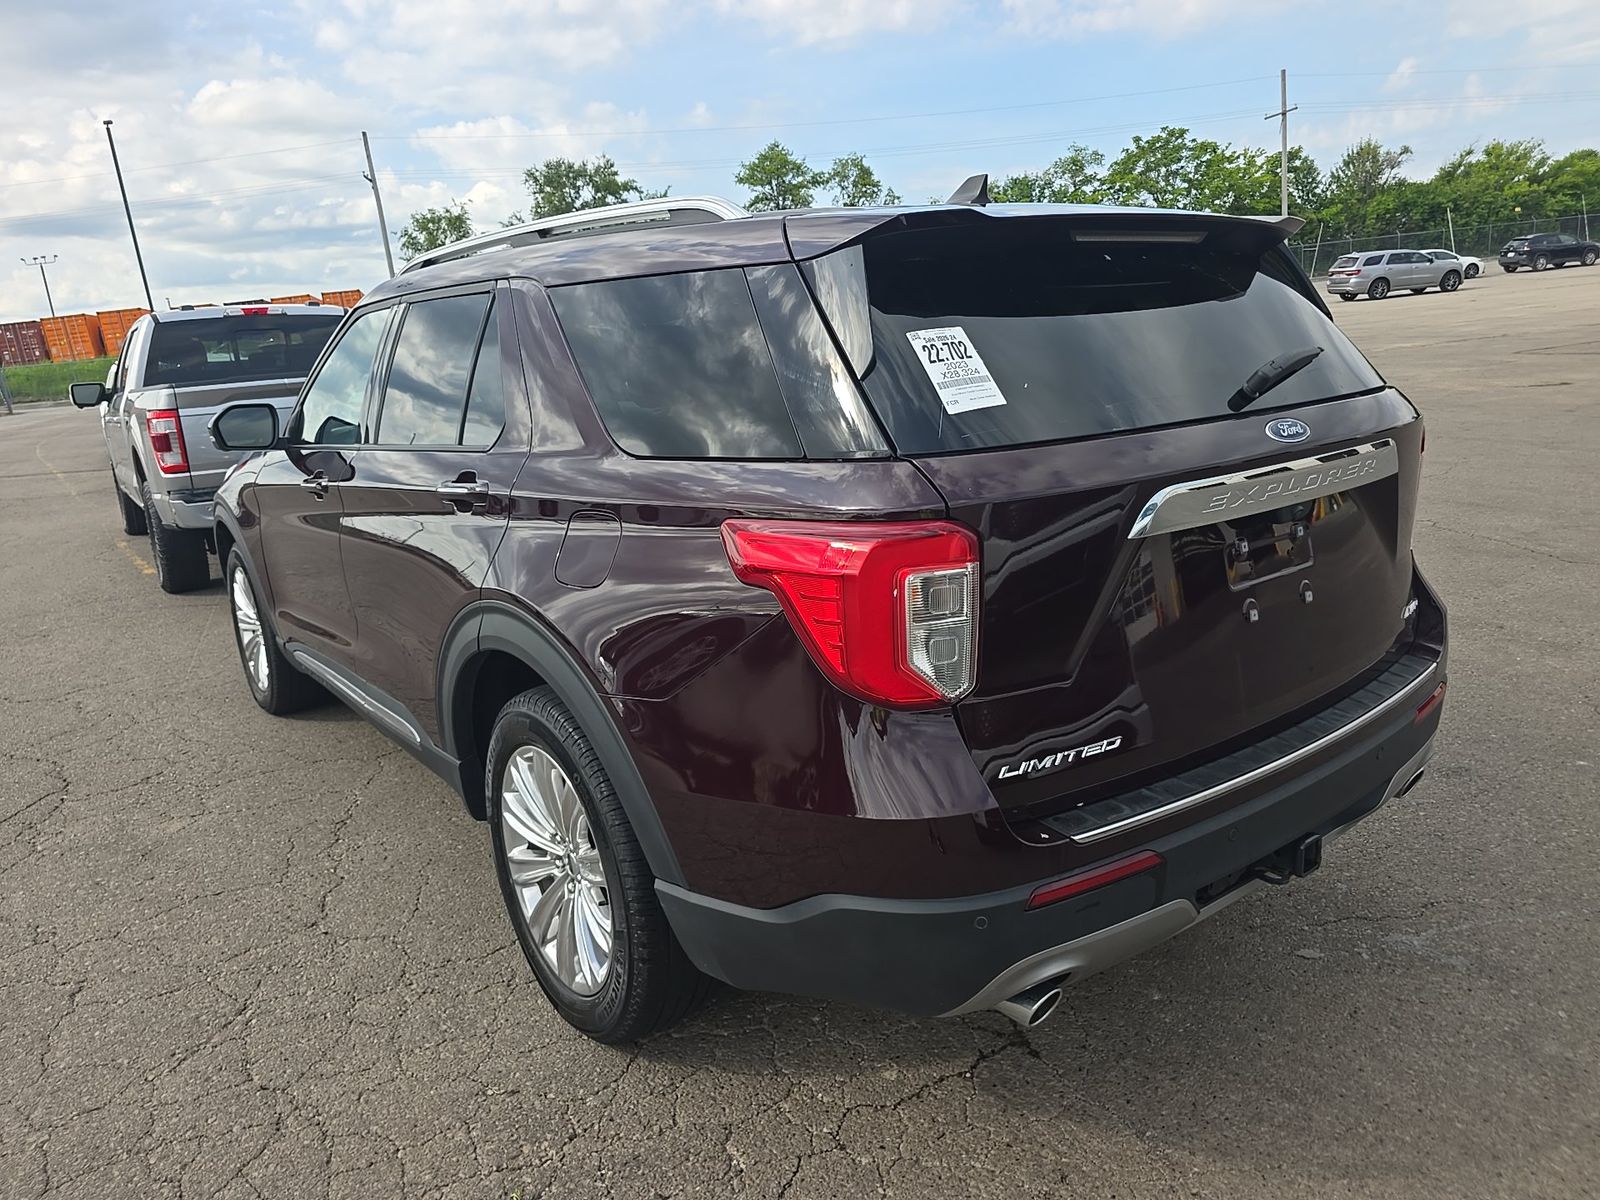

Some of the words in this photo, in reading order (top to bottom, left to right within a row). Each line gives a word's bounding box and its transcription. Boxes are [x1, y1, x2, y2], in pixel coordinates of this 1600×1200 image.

[922, 340, 973, 364] 22:702
[943, 361, 969, 371] 2023
[1277, 421, 1304, 437] Ford
[1202, 458, 1378, 513] EXPLORER
[998, 735, 1123, 779] LIMITED
